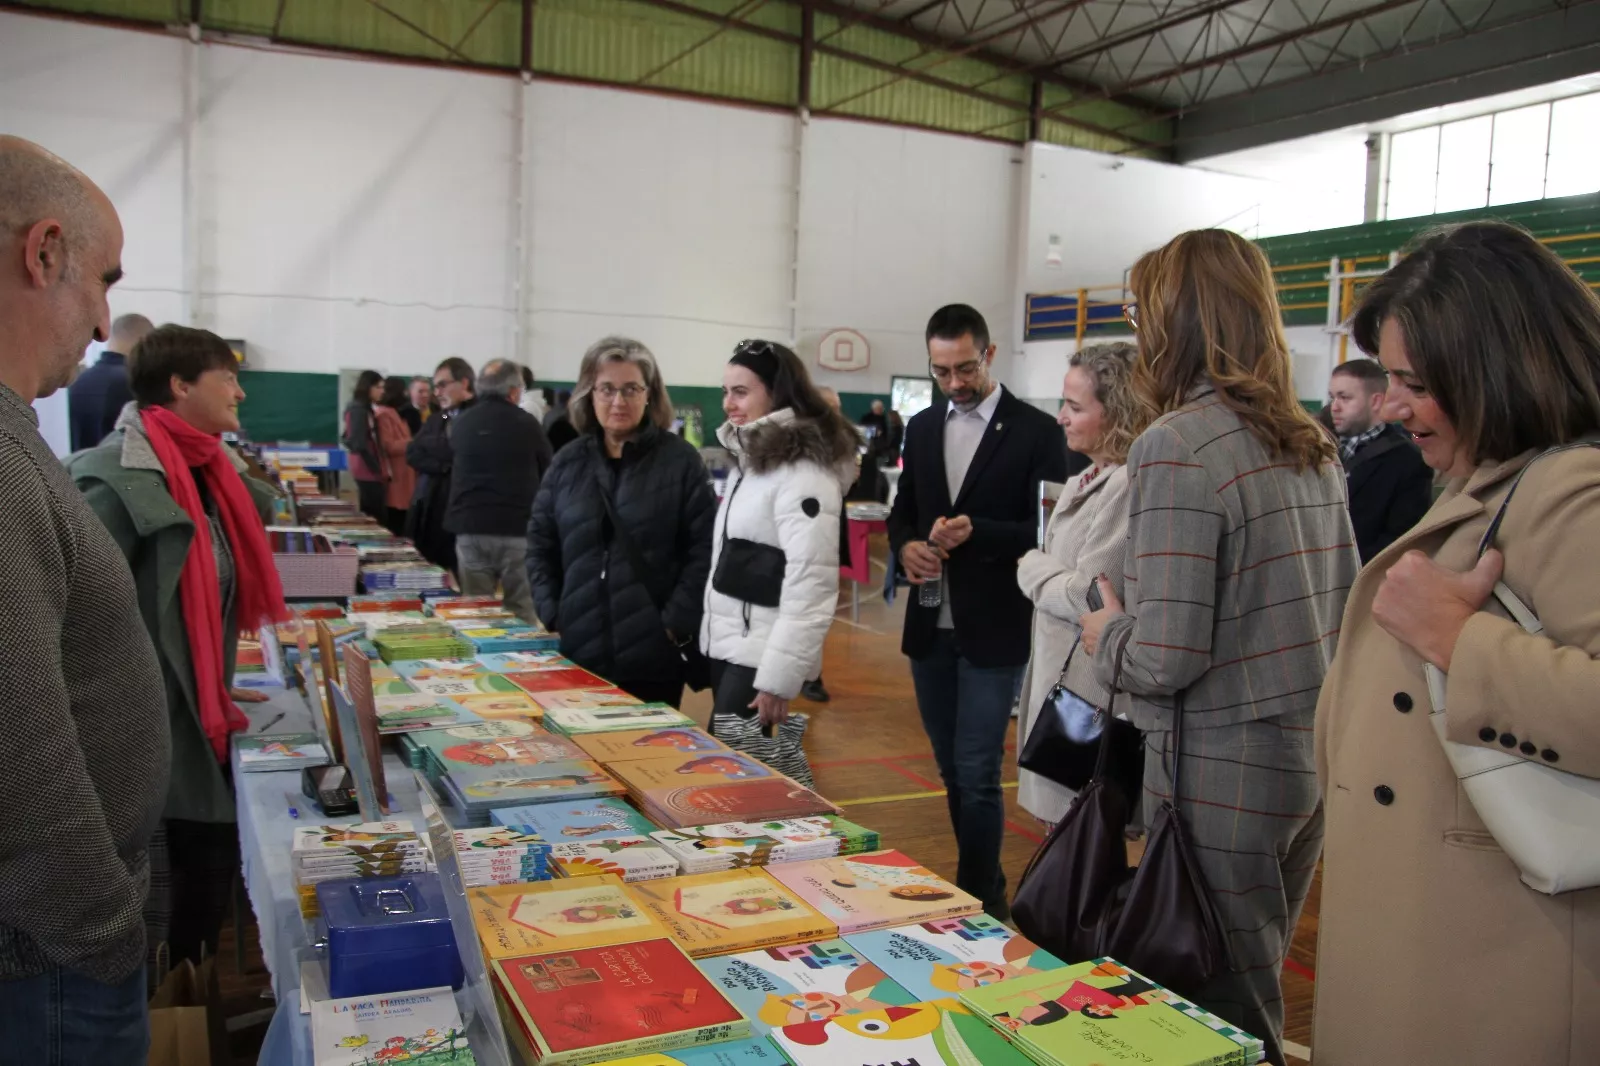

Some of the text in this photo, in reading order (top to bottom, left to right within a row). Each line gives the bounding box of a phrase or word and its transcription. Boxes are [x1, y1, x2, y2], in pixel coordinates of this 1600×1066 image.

[884, 949, 904, 959] DON
[889, 940, 924, 961] DOMINGO
[623, 976, 635, 988] LA
[719, 977, 738, 988] DON
[726, 967, 758, 991] DOMINGO
[333, 1005, 348, 1013] LA
[351, 1002, 374, 1011] VACA
[1078, 1030, 1113, 1051] MADRE
[1111, 1037, 1132, 1050] UNA
[1131, 1051, 1154, 1063] ES
